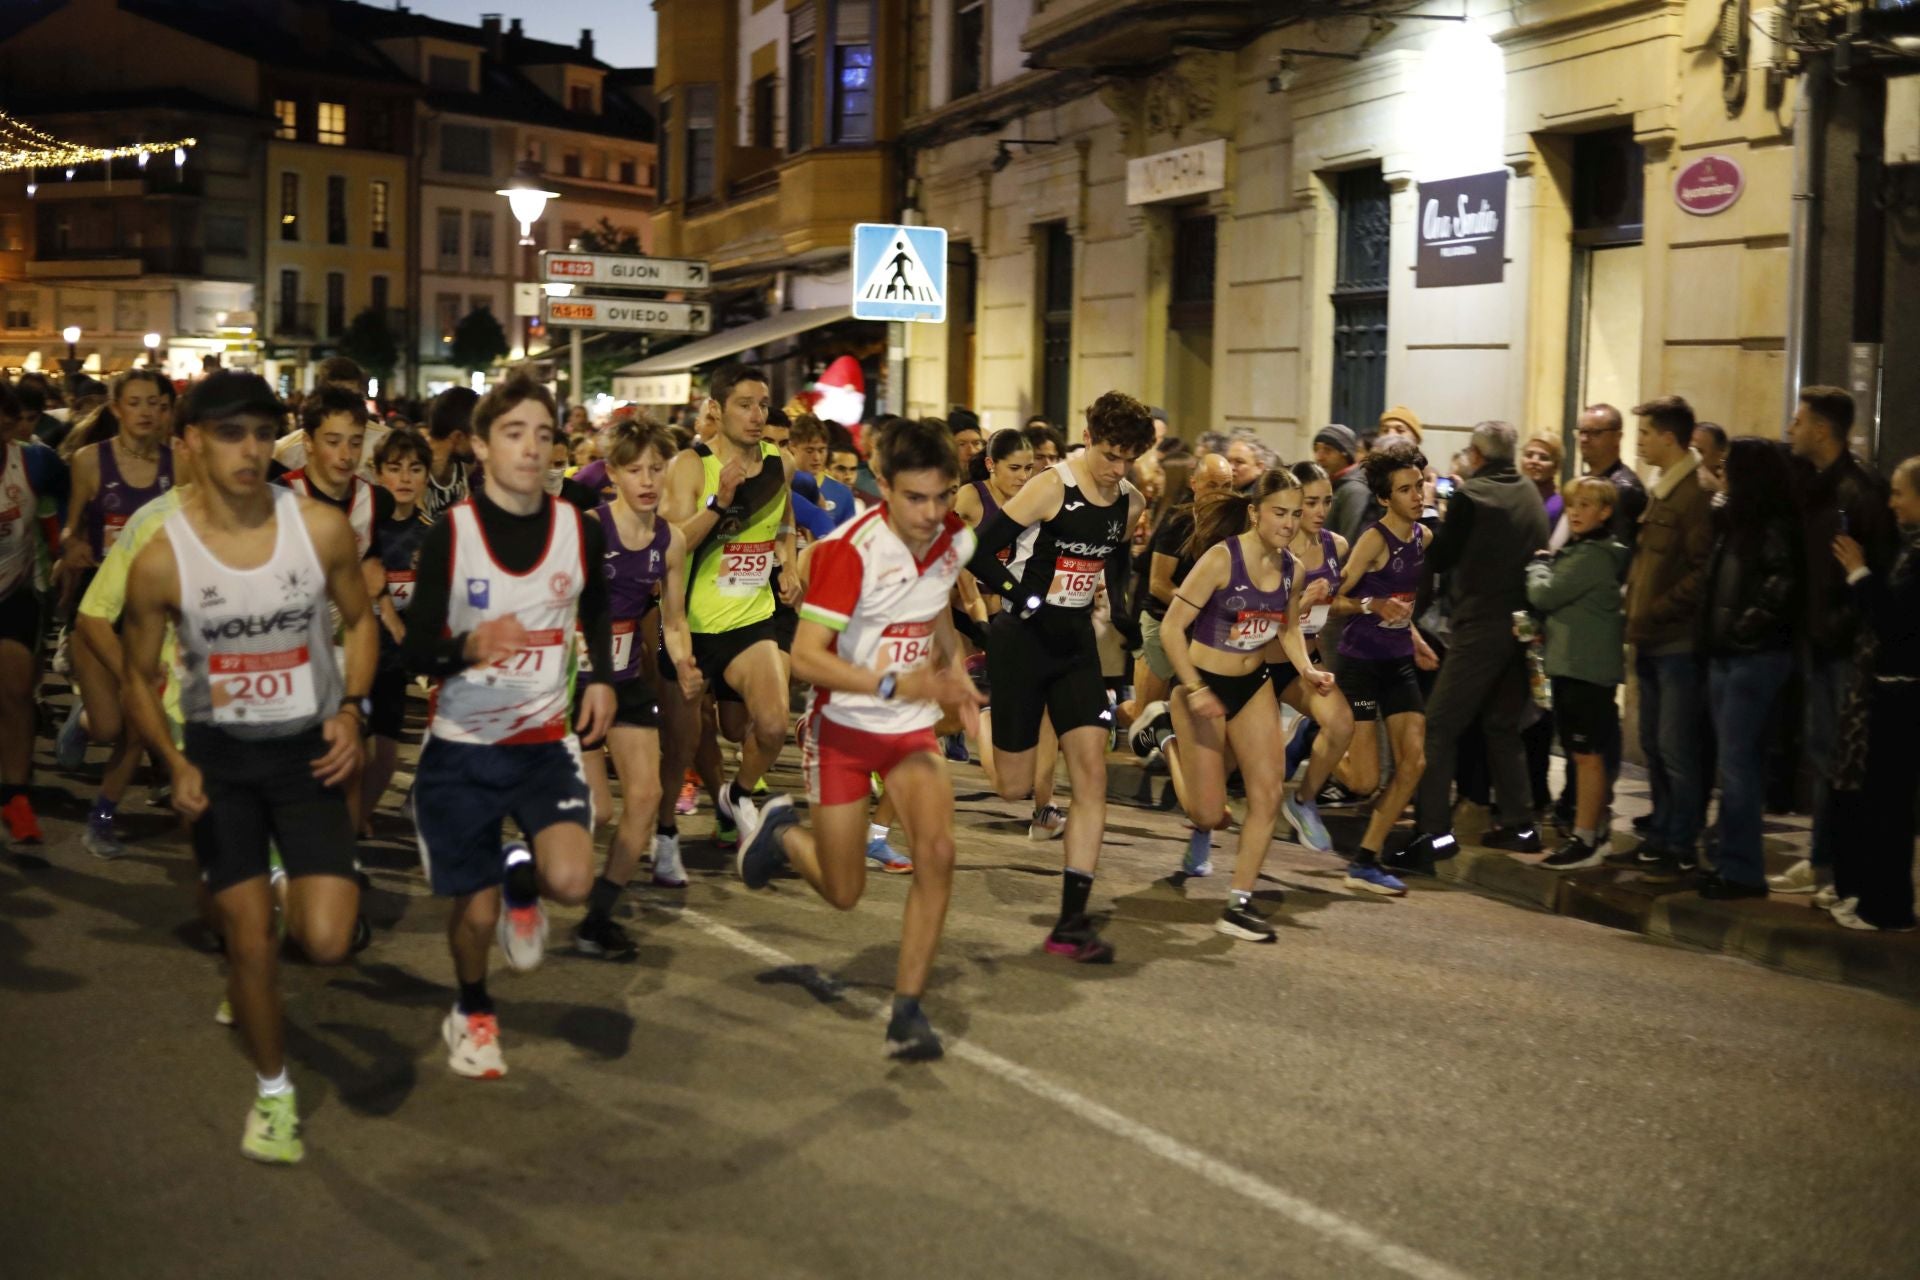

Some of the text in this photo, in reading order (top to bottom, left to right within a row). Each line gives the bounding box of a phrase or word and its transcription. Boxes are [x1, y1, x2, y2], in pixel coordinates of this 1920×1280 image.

[610, 264, 661, 278] GIJON
[607, 307, 669, 323] OVIEDO
[729, 555, 768, 572] 259
[1065, 573, 1096, 592] 165
[201, 606, 316, 642] WOLVES
[1241, 618, 1271, 635] 210
[894, 640, 930, 663] 184
[231, 671, 294, 700] 201
